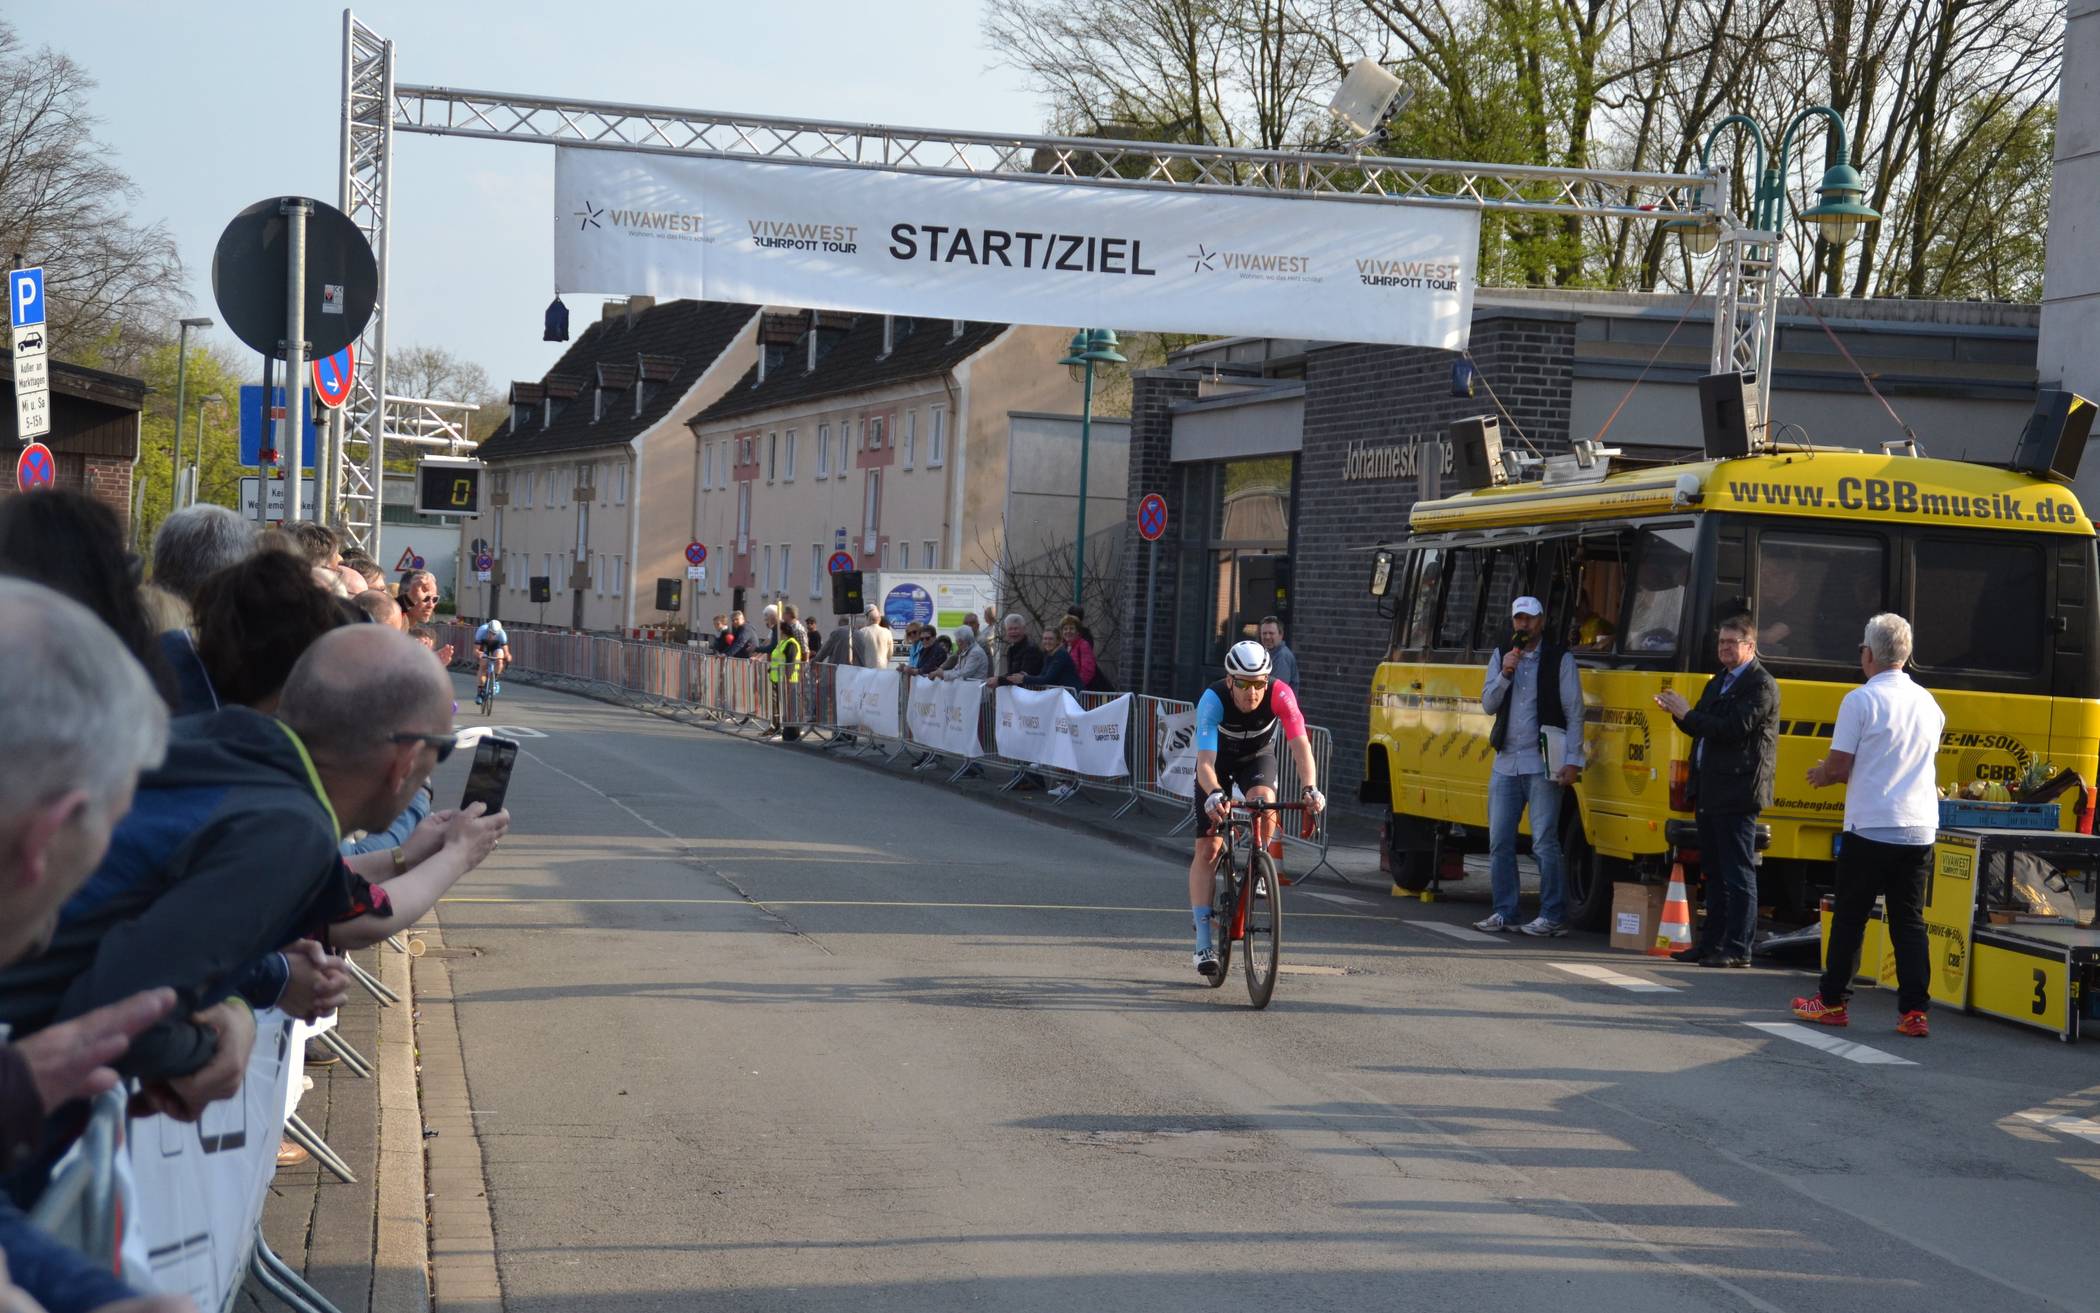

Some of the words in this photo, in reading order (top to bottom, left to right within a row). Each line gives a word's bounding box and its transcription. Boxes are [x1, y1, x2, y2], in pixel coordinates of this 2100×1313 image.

[610, 209, 704, 233] VIVAWEST
[748, 219, 858, 242] VIVAWEST
[753, 235, 818, 252] RUHRPOTT
[823, 241, 858, 255] TOUR
[889, 223, 1156, 275] START/ZIEL
[1222, 252, 1310, 273] VIVAWEST
[1355, 258, 1459, 280] VIVAWEST
[1360, 274, 1422, 289] RUHRPOTT
[1426, 278, 1458, 292] TOUR
[18, 277, 36, 323] P
[20, 363, 36, 374] Außer
[36, 361, 43, 371] an
[18, 375, 46, 389] Markttagen
[22, 400, 30, 413] Mi
[37, 396, 46, 409] Sa
[1343, 432, 1454, 480] Johanneskihe
[451, 479, 471, 505] 0
[1729, 476, 2076, 524] www.CBBmusik.de
[1629, 743, 1645, 761] CBB
[1976, 764, 2017, 781] CBB
[1942, 854, 1969, 869] VIVAWEST
[2031, 967, 2047, 1016] 3
